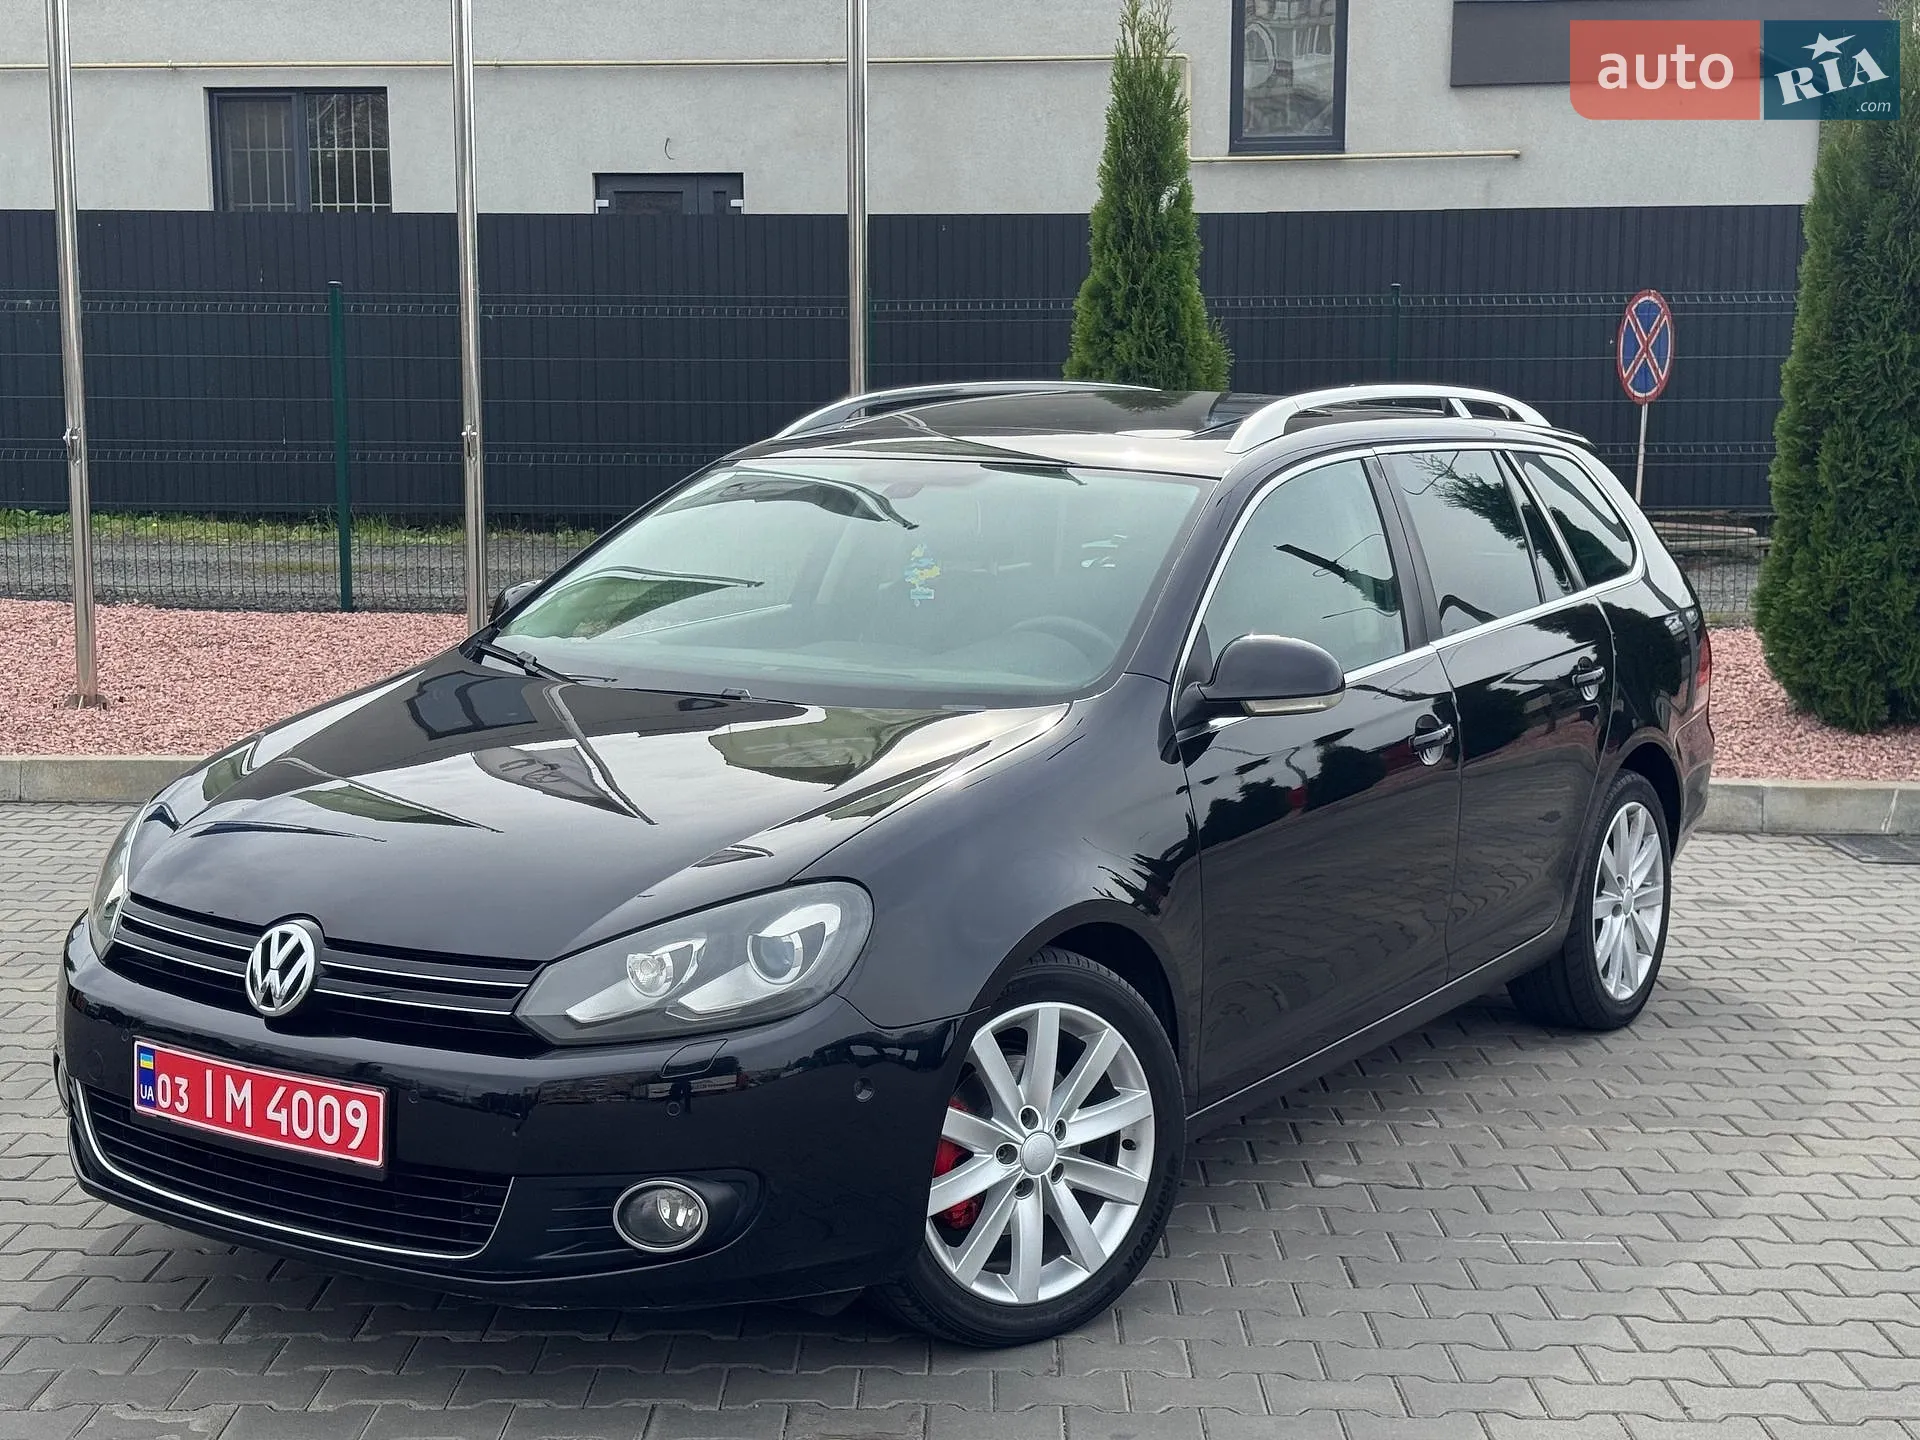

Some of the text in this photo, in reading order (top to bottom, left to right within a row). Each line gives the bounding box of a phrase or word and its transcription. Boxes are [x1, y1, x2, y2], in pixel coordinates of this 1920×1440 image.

[140, 1083, 155, 1102] UA
[157, 1069, 368, 1150] 03 IM 4009
